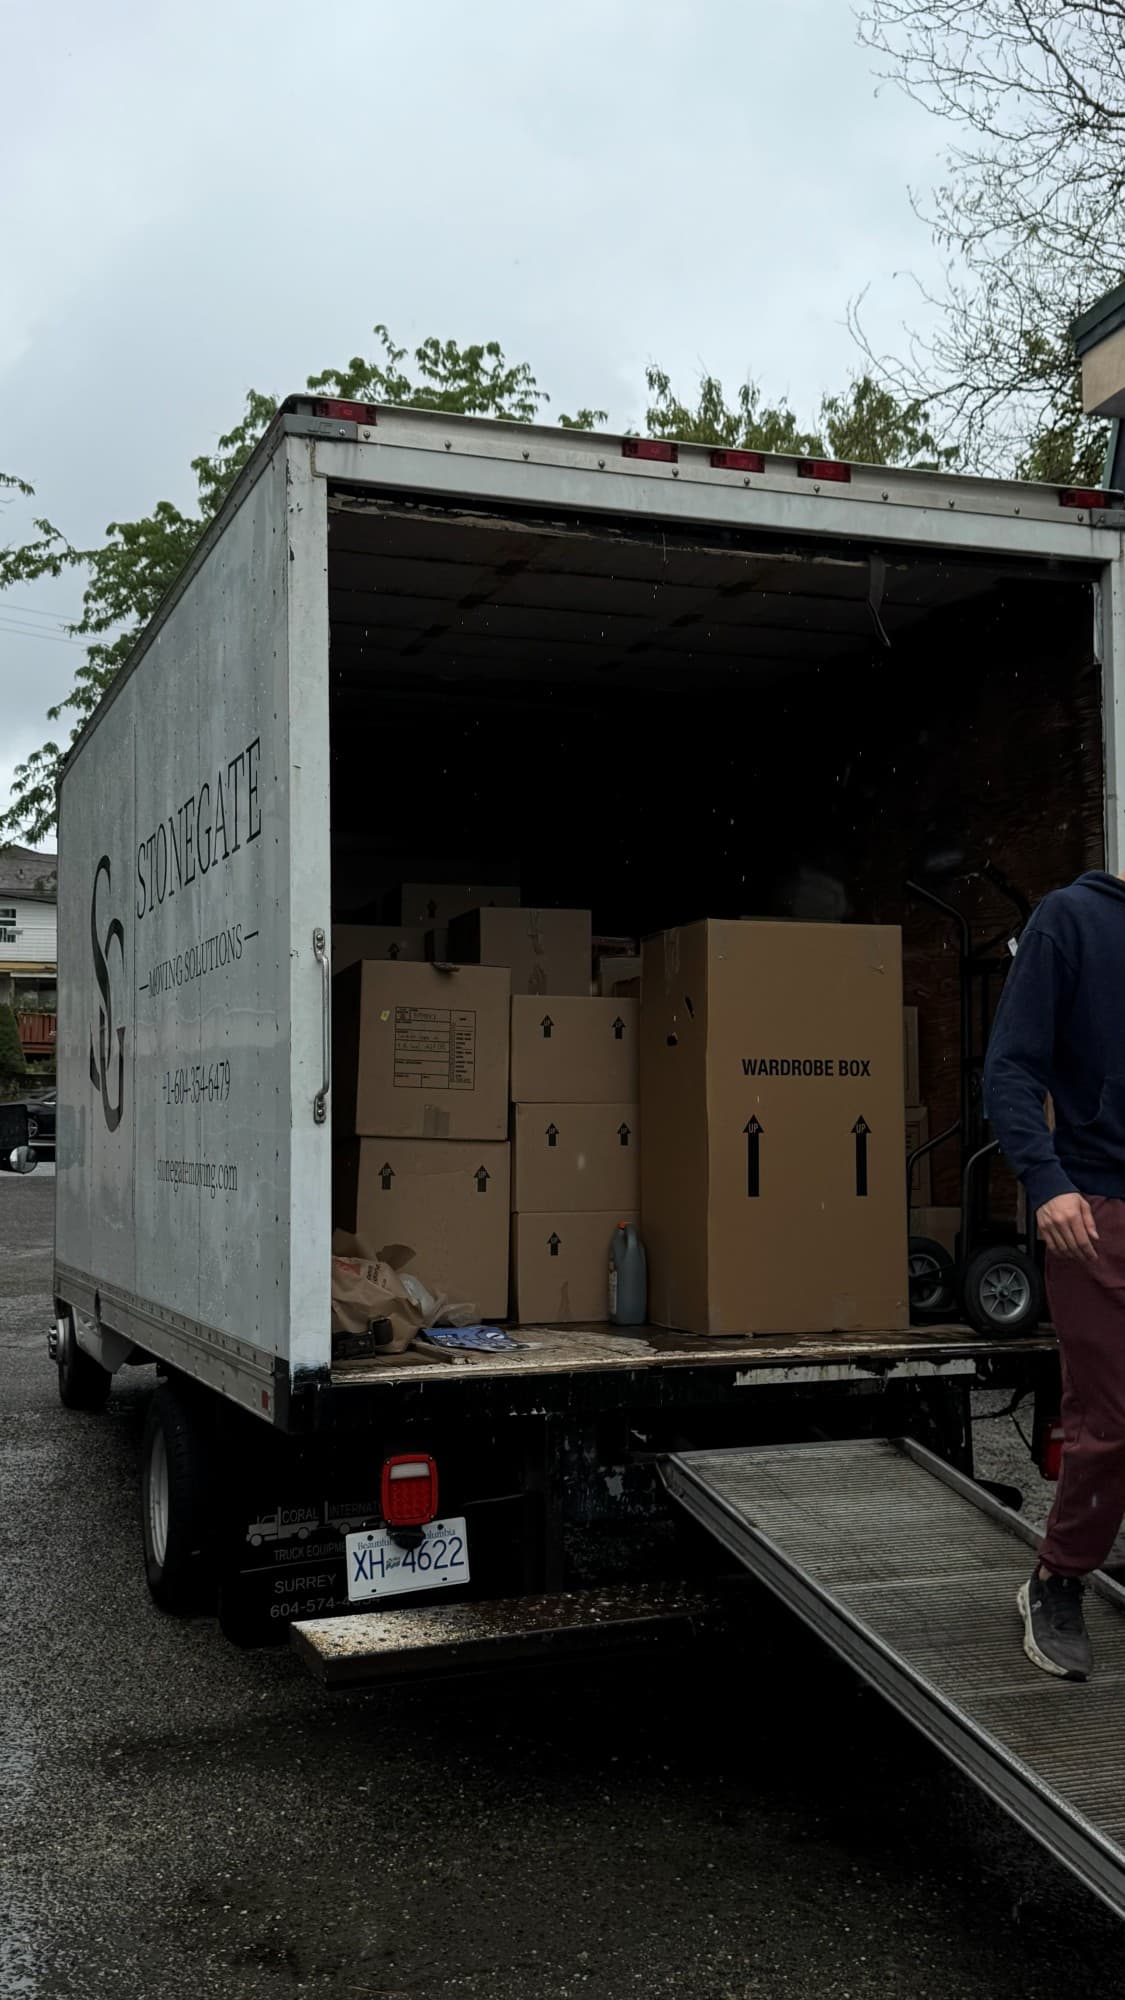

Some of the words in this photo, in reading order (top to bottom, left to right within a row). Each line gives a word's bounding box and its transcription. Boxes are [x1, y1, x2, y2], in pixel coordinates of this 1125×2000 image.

[136, 736, 262, 919] STONEGATE
[149, 954, 182, 996] MOVING
[184, 923, 242, 982] SOLUTIONS
[742, 1059, 834, 1076] WARDROBE
[838, 1060, 871, 1077] BOX
[748, 1123, 759, 1133] UP
[856, 1123, 866, 1133] UP
[282, 1506, 320, 1524] CORAL
[357, 1537, 392, 1550] Beautiful
[424, 1527, 456, 1540] olumbia
[272, 1546, 305, 1561] TRUCK
[307, 1540, 346, 1557] EQUIPME
[352, 1548, 384, 1582] XH
[401, 1536, 464, 1573] 4622
[274, 1573, 336, 1594] SURREY
